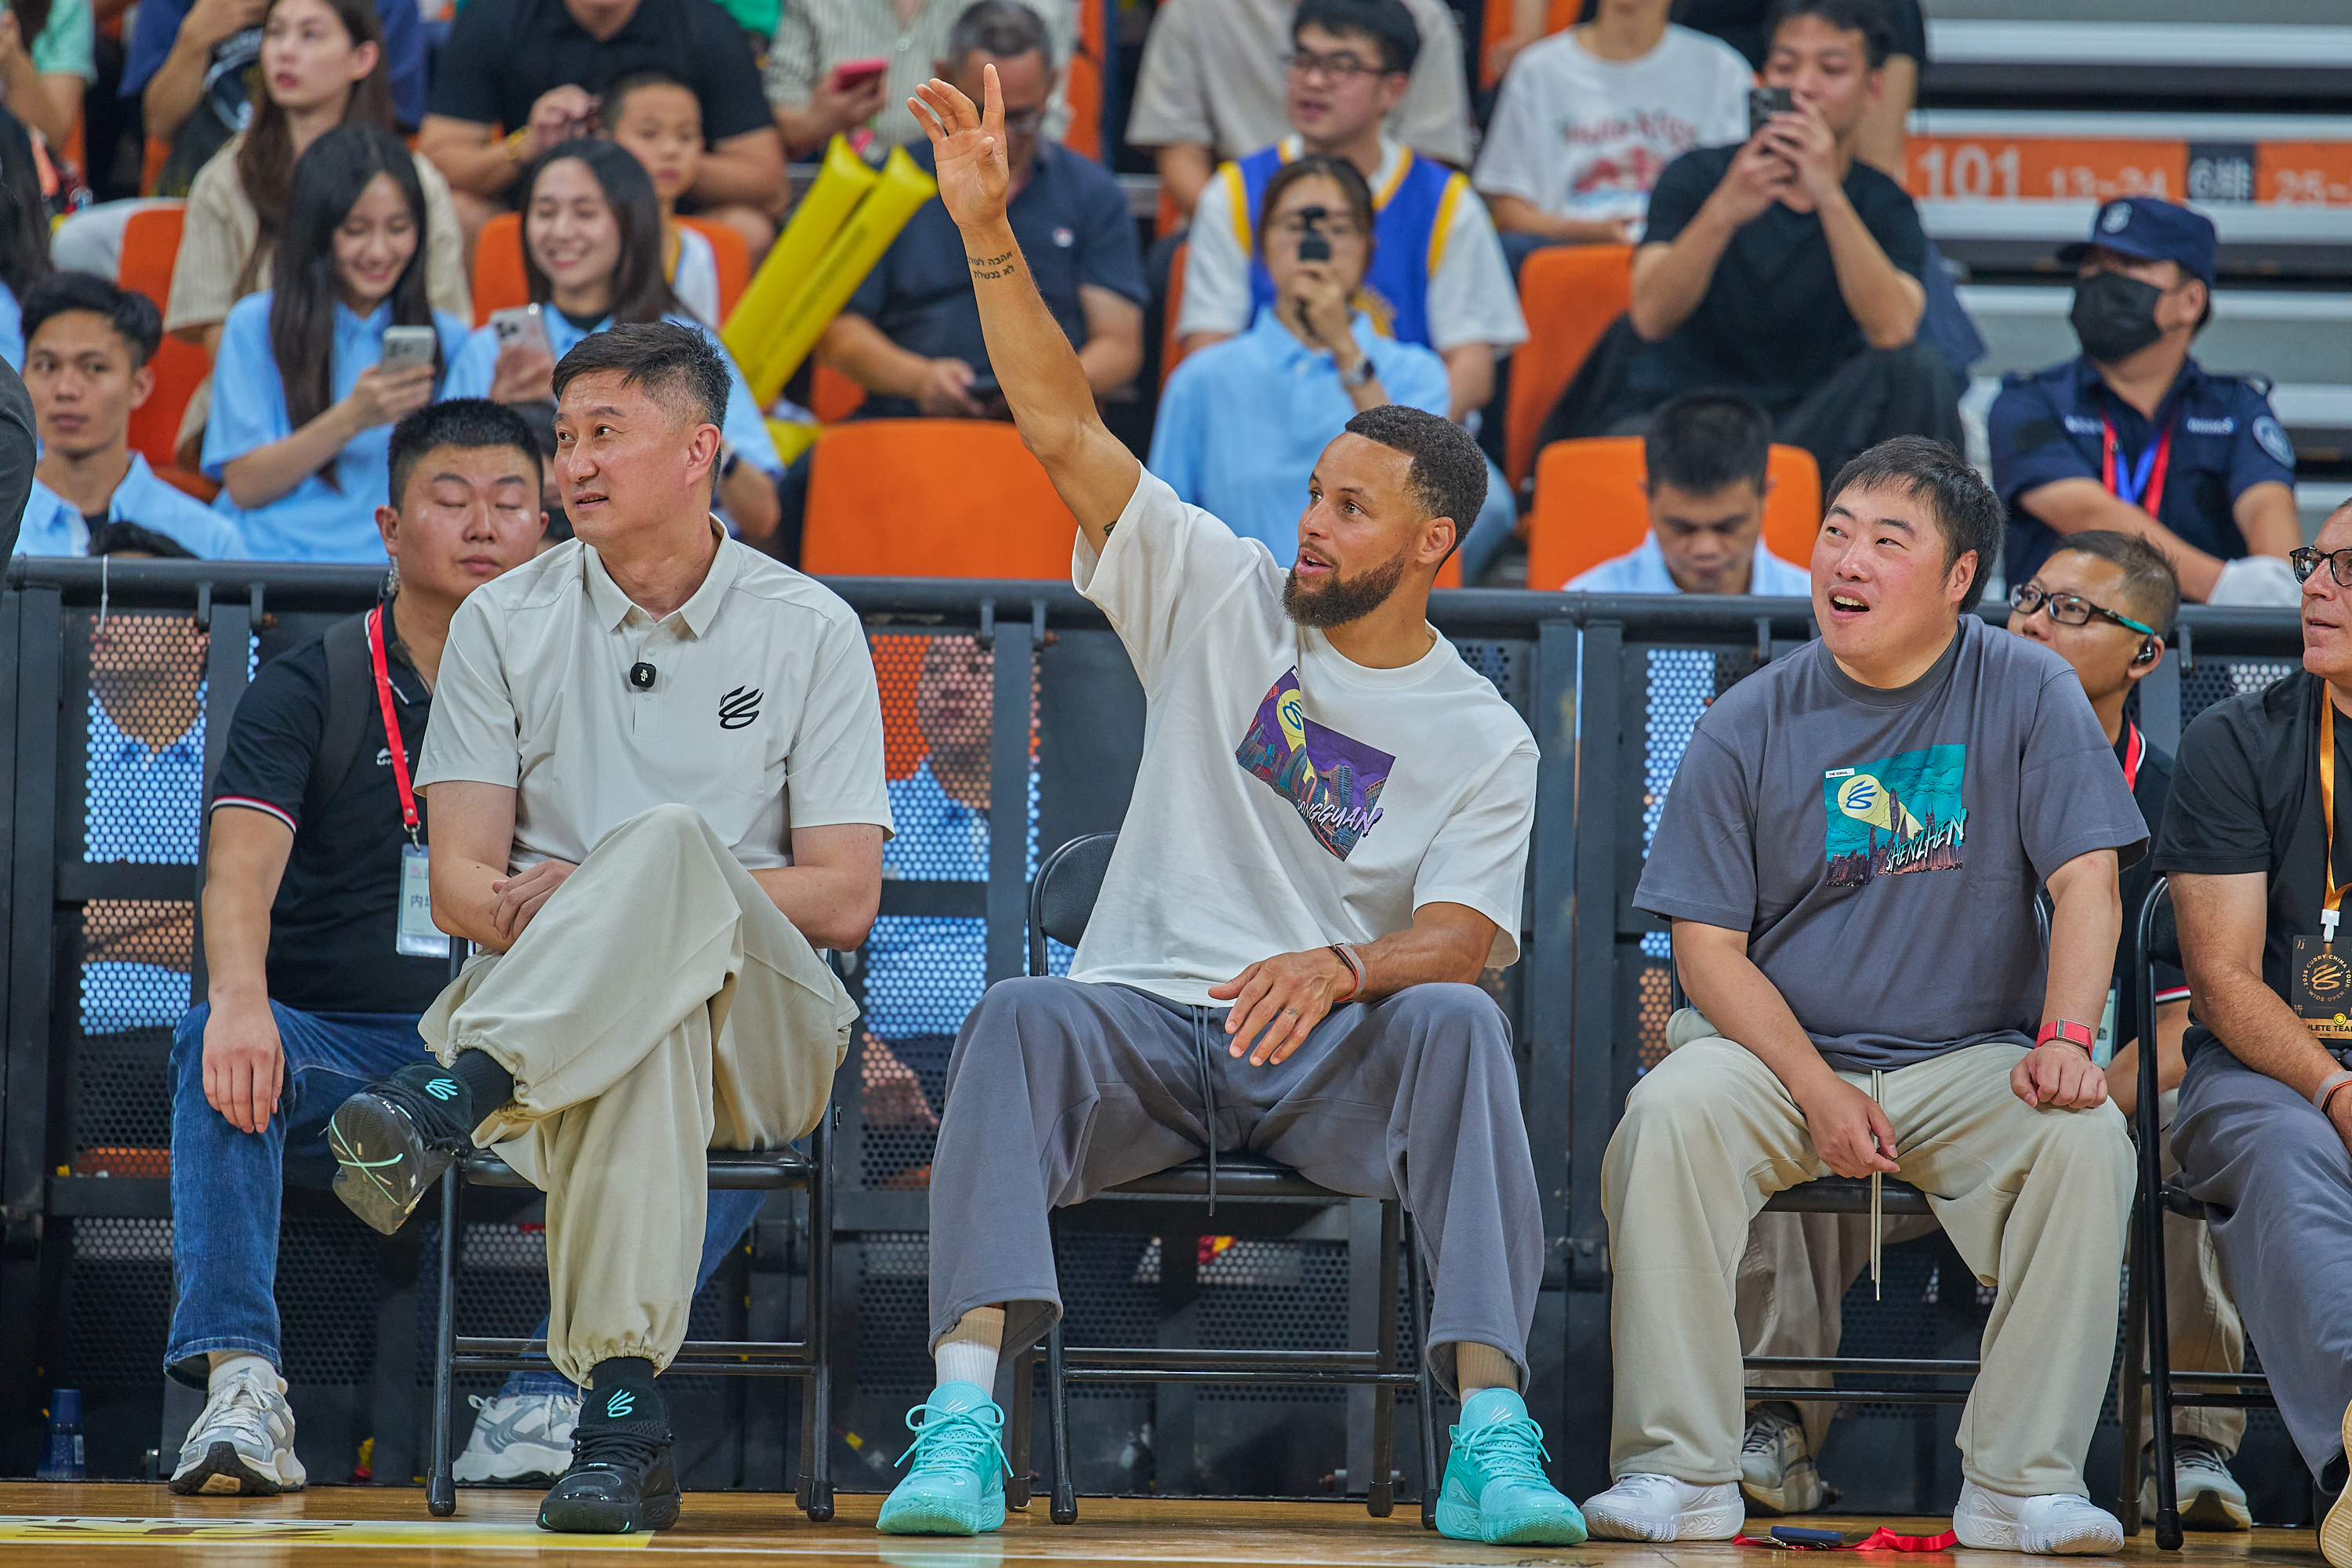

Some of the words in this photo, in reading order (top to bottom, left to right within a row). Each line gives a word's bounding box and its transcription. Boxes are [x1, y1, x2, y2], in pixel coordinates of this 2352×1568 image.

[1917, 143, 2021, 201] 101
[1003, 264, 1014, 275] לא
[1298, 799, 1384, 836] DONGGUAN
[1886, 808, 1969, 872] SHENZHEN
[2306, 954, 2326, 968] CURRY
[2328, 954, 2347, 969] CHINA
[2308, 989, 2325, 1002] WIDE
[2327, 990, 2345, 1002] OPEN
